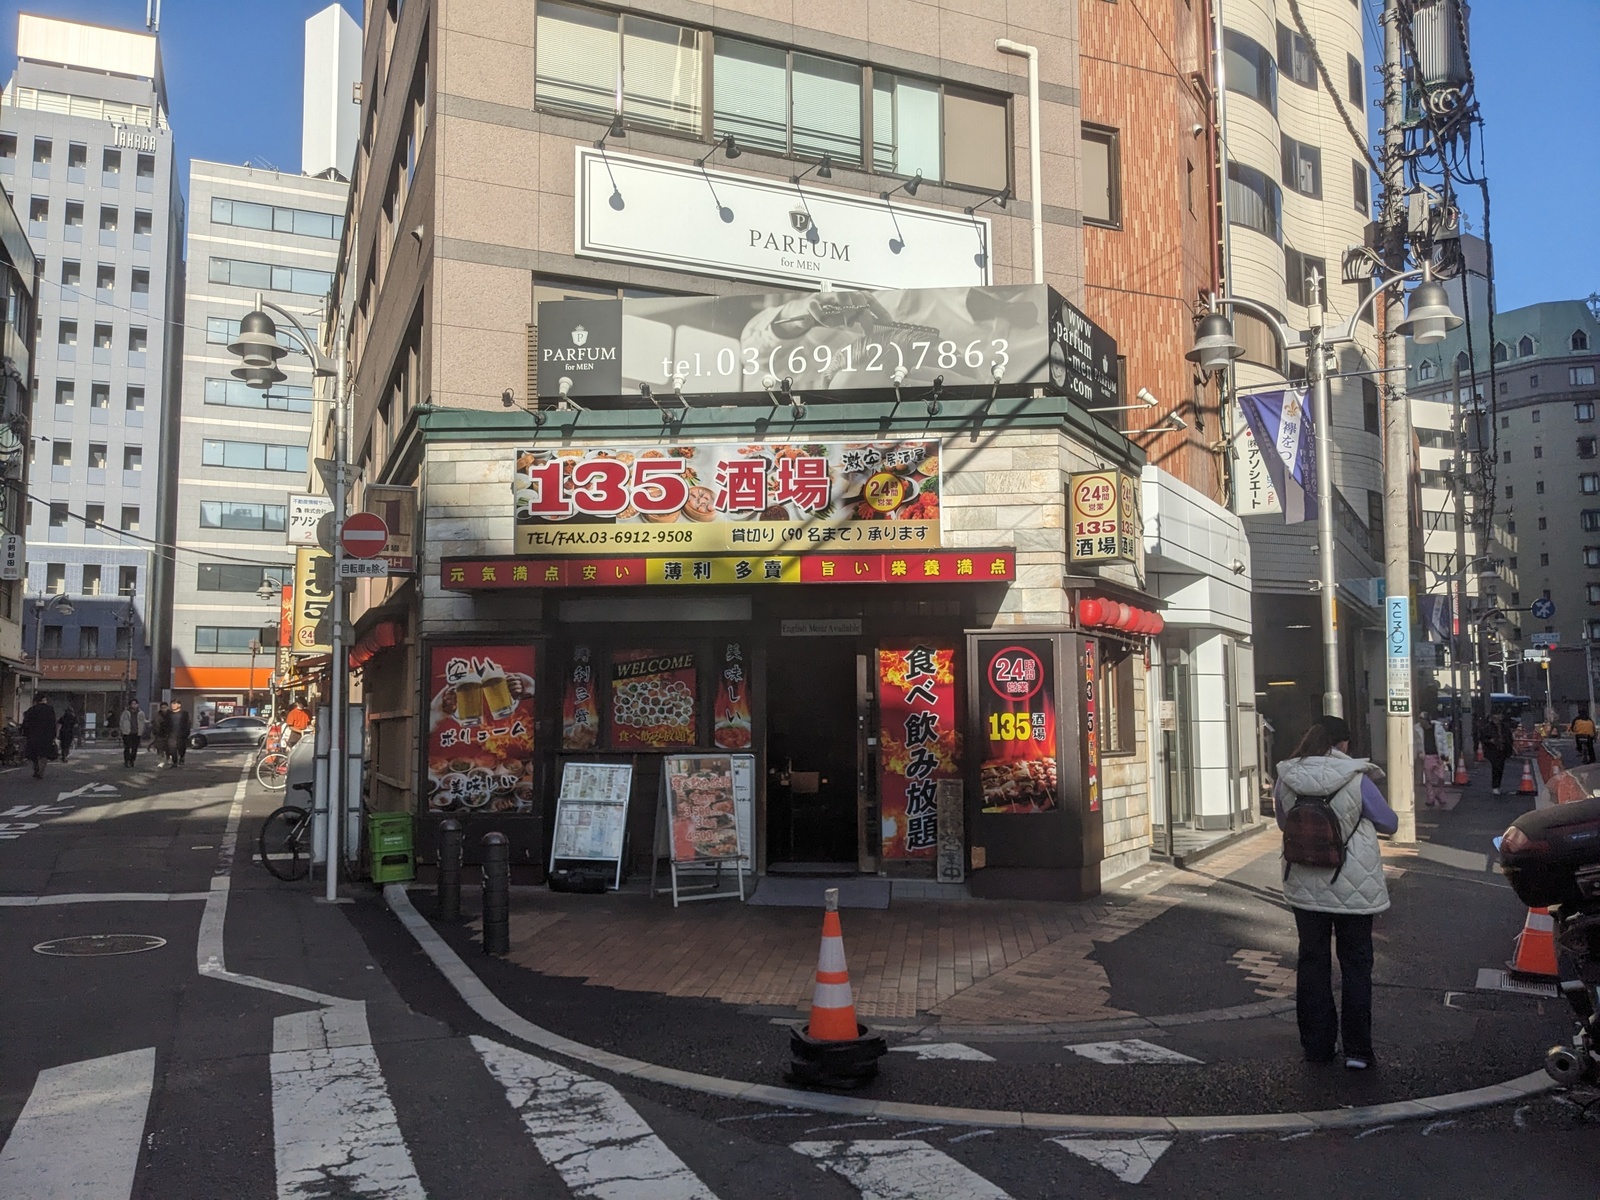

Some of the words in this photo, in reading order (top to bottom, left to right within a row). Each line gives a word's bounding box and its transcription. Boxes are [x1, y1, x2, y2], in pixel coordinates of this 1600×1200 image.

[749, 229, 850, 262] PARFUM
[781, 257, 794, 267] for
[797, 260, 821, 271] MEN
[543, 347, 616, 361] PARFUM
[576, 363, 594, 371] MEN
[1070, 377, 1092, 401] .com
[1280, 421, 1297, 469] 襷をつ
[843, 449, 880, 471] 激安
[886, 448, 924, 466] 居酒屋
[529, 458, 690, 515] 135
[714, 457, 831, 512] 酒場
[527, 530, 693, 546] TEL/FAX.03-6912-9508
[1075, 520, 1116, 536] 135
[1121, 520, 1133, 536] 135
[1076, 536, 1116, 556] 酒場
[341, 563, 385, 574] 自転車を除く
[450, 565, 560, 583] 元気満点
[582, 564, 630, 580] 安い
[821, 560, 869, 576] 旨い
[891, 558, 1006, 576] 栄養満点
[1391, 602, 1405, 654] KUMON
[617, 654, 694, 677] WELCOME
[724, 643, 743, 724] 美味しい
[440, 720, 526, 747] ボリューム
[988, 712, 1031, 741] 135
[1032, 712, 1046, 741] 酒場
[903, 644, 939, 852] 食べ飲み放題
[449, 775, 518, 797] 美味しい
